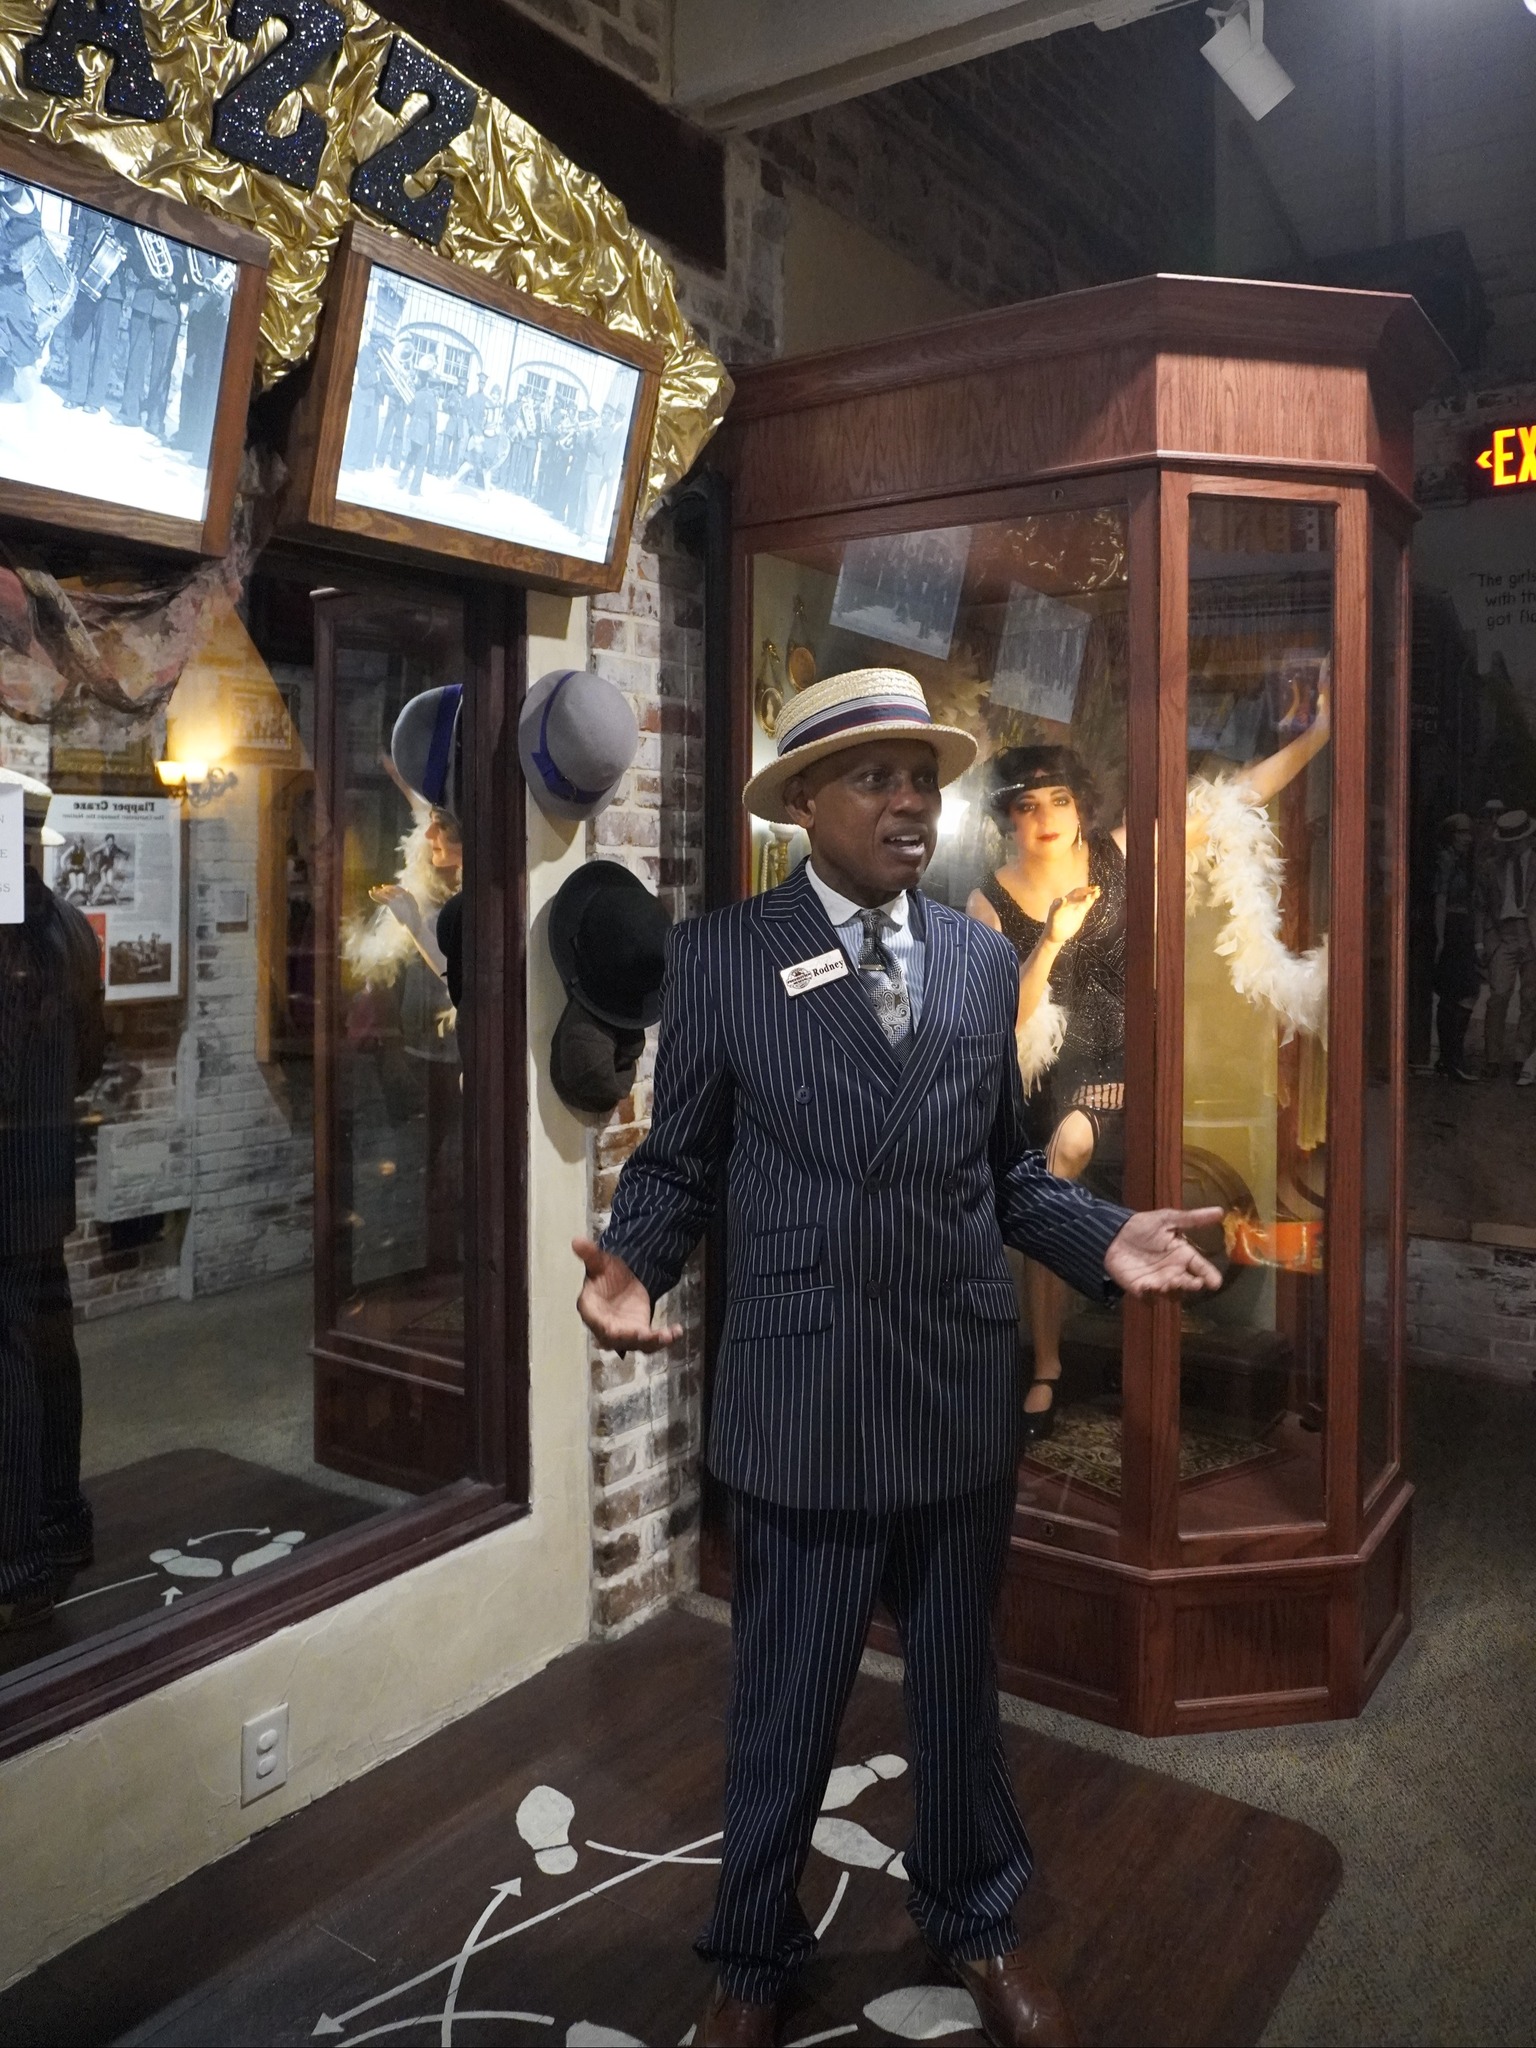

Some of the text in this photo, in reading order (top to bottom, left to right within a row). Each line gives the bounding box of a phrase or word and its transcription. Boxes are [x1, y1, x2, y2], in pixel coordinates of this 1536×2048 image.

[1493, 425, 1536, 485] EX
[1485, 591, 1516, 607] with
[1487, 612, 1511, 631] got
[812, 959, 844, 977] Rodney
